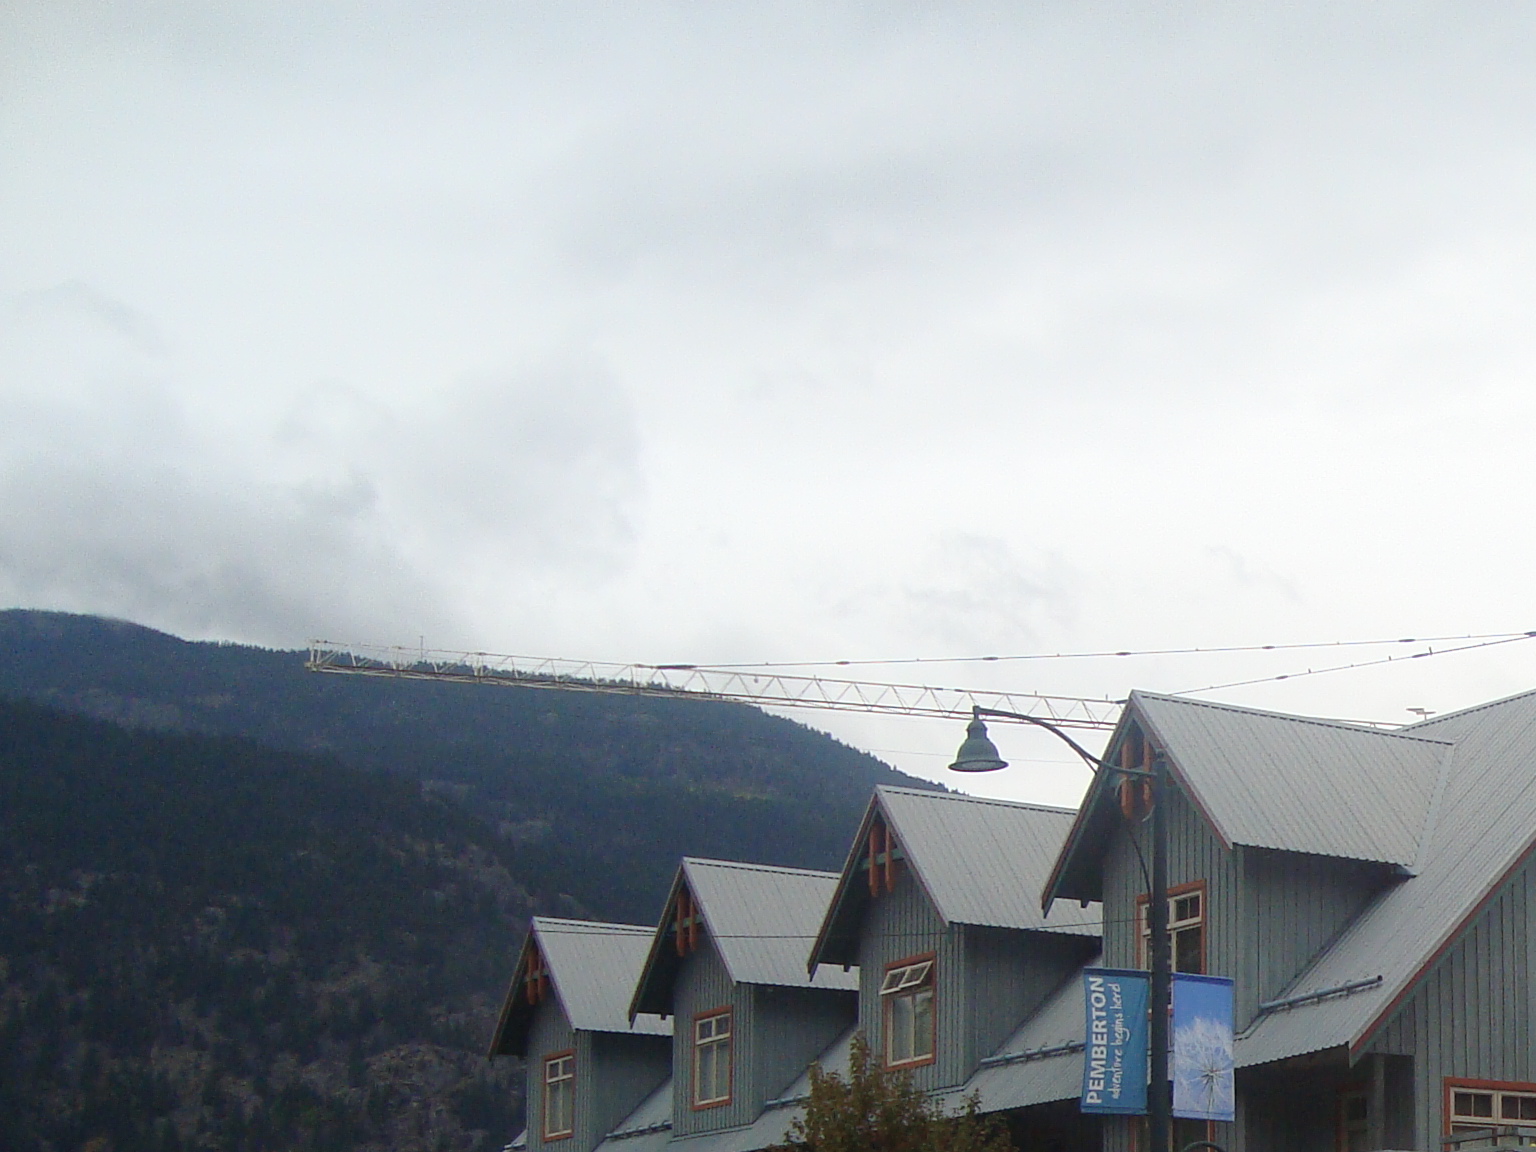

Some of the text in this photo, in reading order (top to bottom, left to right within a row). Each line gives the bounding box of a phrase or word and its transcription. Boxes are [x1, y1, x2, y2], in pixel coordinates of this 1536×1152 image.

[1086, 976, 1108, 1104] PEMBERTON
[1110, 1013, 1131, 1045] begins
[1105, 1048, 1123, 1099] adventure
